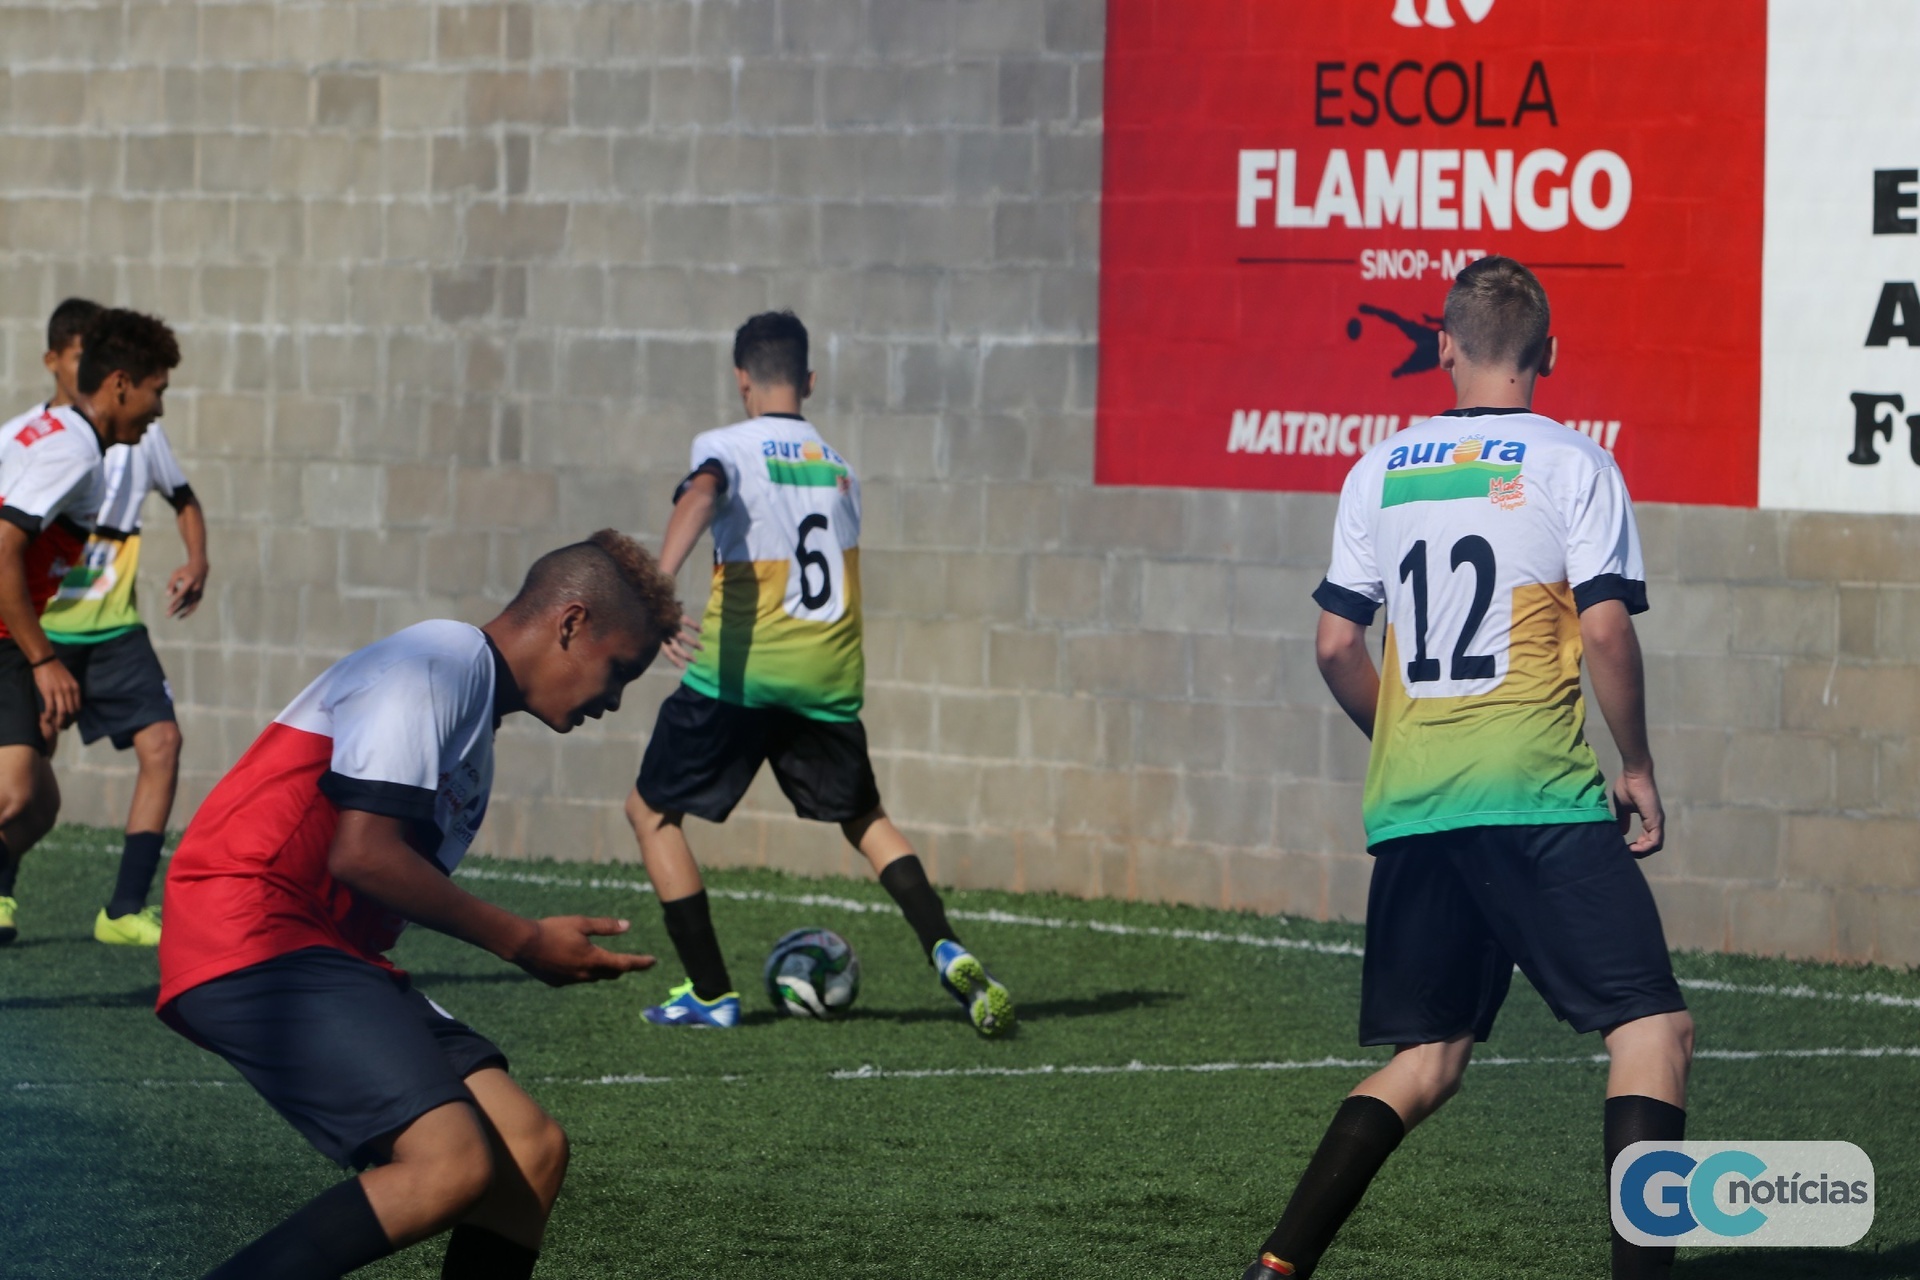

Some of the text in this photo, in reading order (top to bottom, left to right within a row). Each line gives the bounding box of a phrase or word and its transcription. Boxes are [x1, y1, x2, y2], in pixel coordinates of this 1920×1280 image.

[1314, 60, 1558, 128] ESCOLA
[1236, 148, 1632, 232] FLAMENGO
[1387, 440, 1527, 470] aurora
[795, 513, 831, 610] 6
[1399, 534, 1496, 683] 12
